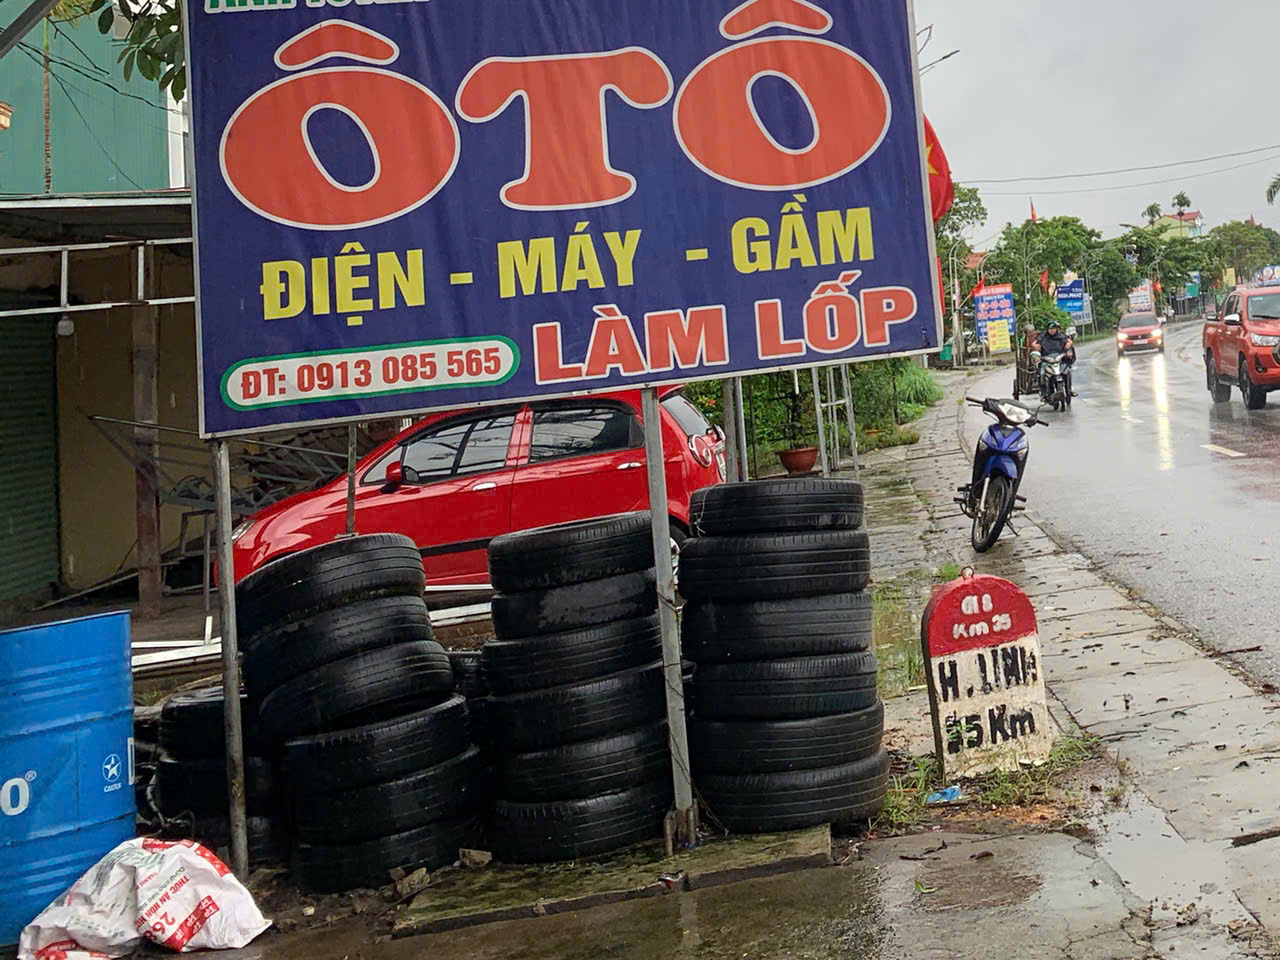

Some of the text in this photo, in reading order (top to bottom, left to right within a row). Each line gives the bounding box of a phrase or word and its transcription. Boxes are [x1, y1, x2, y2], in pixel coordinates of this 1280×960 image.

[260, 242, 424, 326] ĐIỆN
[499, 221, 641, 299] MÁY
[731, 194, 874, 274] GẦM
[241, 346, 502, 401] ĐT: 0913 085 565
[533, 271, 918, 385] LÀM LỐP
